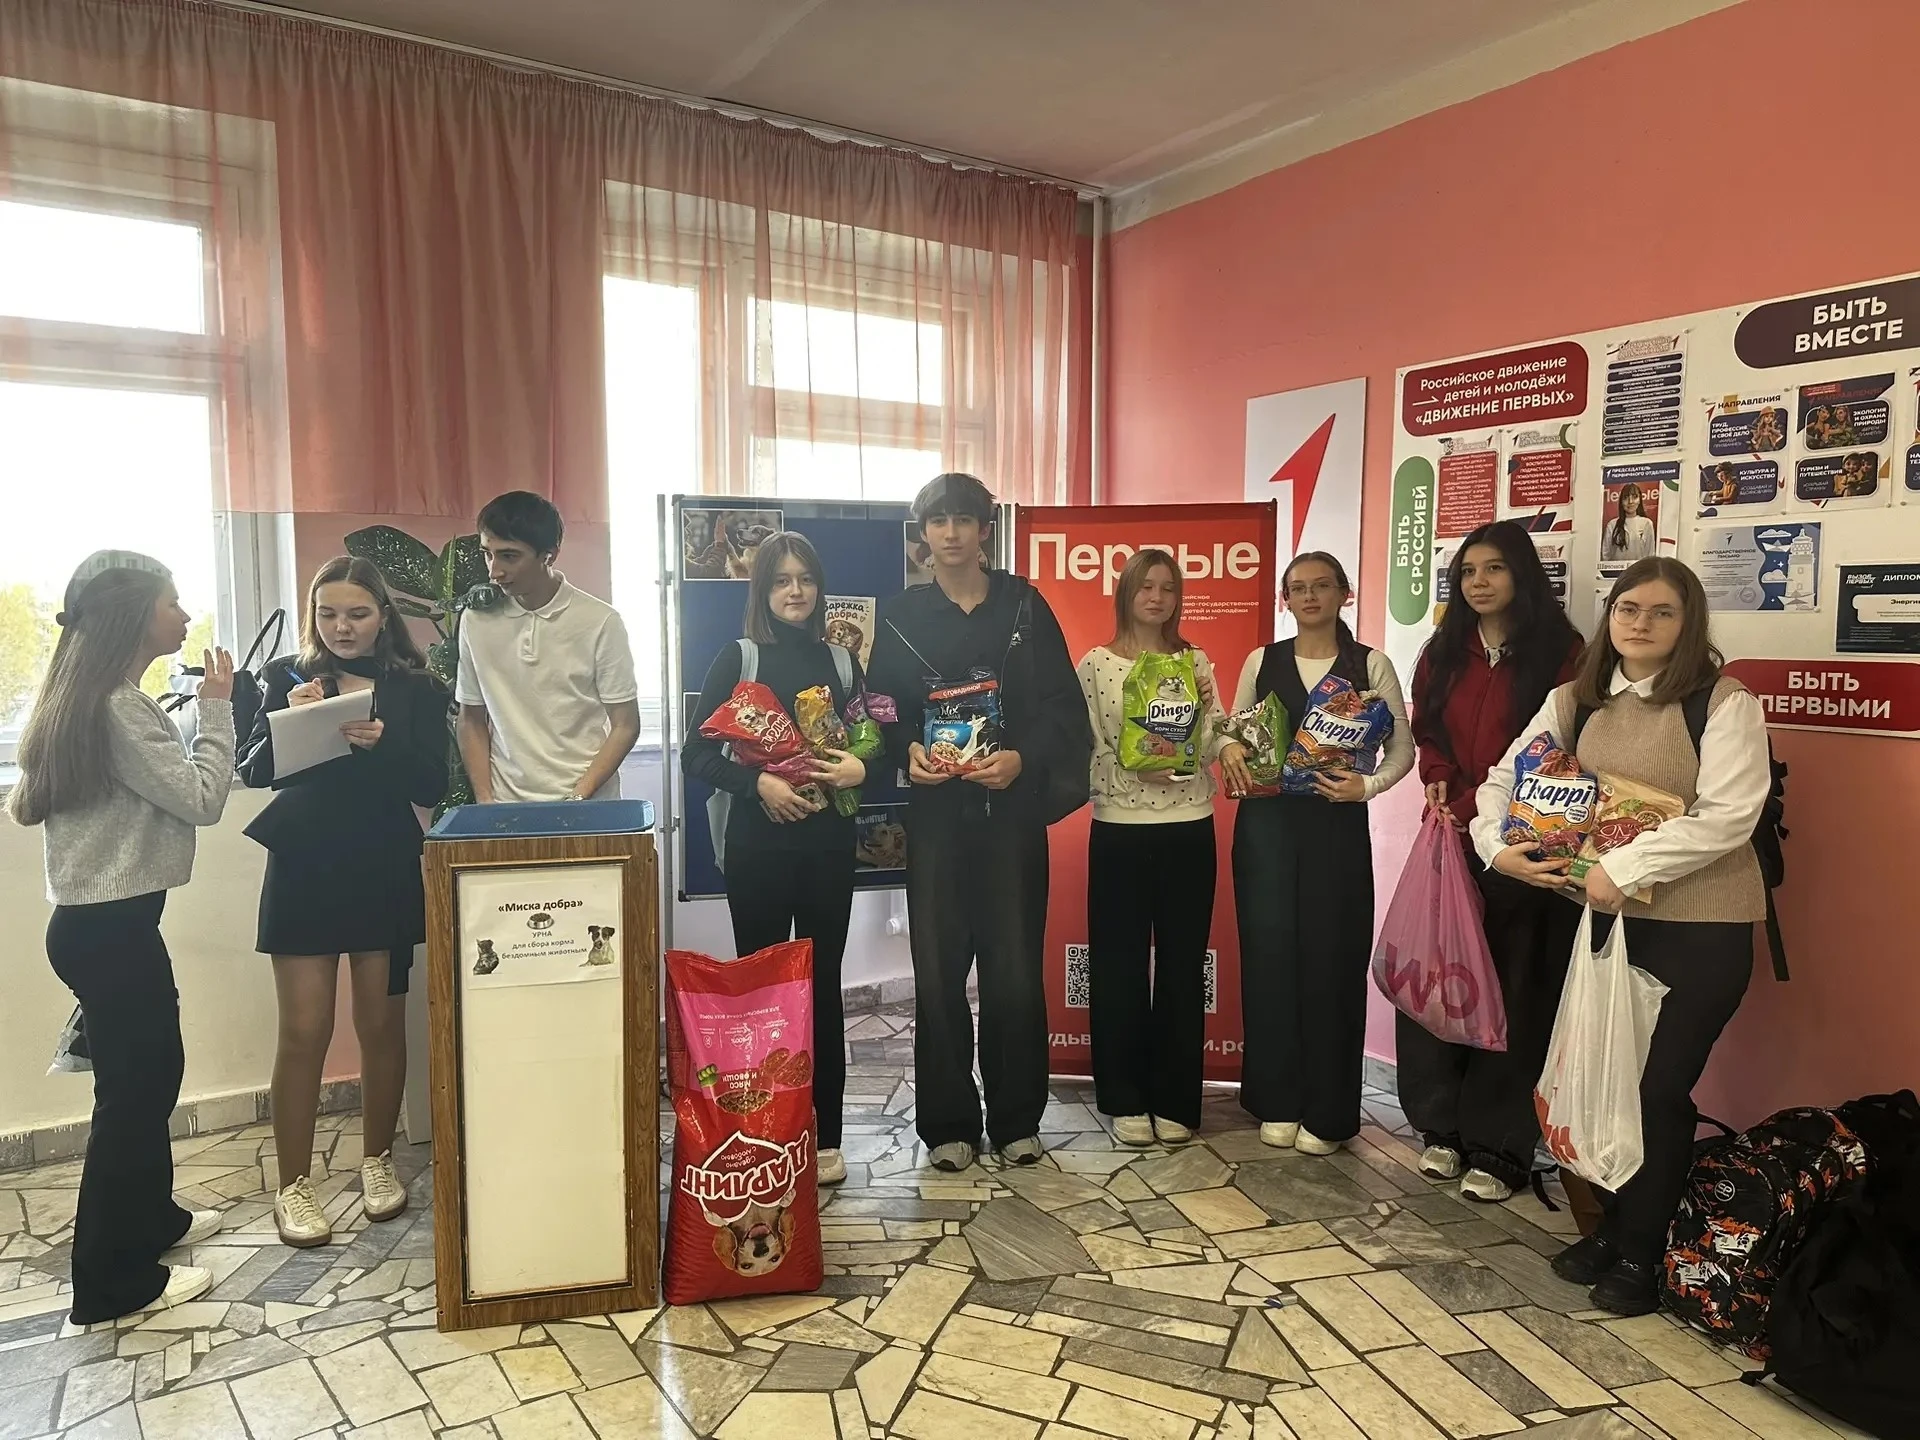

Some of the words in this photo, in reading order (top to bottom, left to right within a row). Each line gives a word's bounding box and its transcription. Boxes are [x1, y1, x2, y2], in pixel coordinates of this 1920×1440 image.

[1812, 296, 1888, 326] БЫТЬ
[1794, 318, 1904, 353] ВМЕСТЕ
[1420, 367, 1495, 392] Российское
[1497, 355, 1568, 380] движение
[1443, 385, 1481, 404] детей
[1483, 386, 1491, 397] и
[1494, 372, 1567, 393] молодёжи
[1415, 399, 1500, 427] «ДВИЖЕНИЕ
[1502, 390, 1575, 413] ПЕРВЫХ»
[1718, 395, 1781, 409] НАПРАВЛЕНИЯ
[1853, 407, 1887, 416] ЭКОЛОГИЯ
[1854, 418, 1887, 427] ПРИРОДЫ
[1860, 413, 1887, 421] ОХРАНА
[1733, 430, 1750, 438] ДЕЛО
[1800, 469, 1843, 477] ПУТЕШЕСТВИЯ
[1396, 514, 1411, 567] БЫТЬ
[1411, 484, 1428, 580] РОССИЕЙ
[1411, 584, 1424, 596] С
[1788, 671, 1860, 692] БЫТЬ
[1151, 703, 1191, 722] Dingo
[1757, 694, 1891, 719] ПЕРВЫМИ
[1302, 711, 1365, 742] Chappi
[1515, 777, 1594, 808] Chappi
[498, 902, 540, 913] «Миска
[543, 899, 583, 912] добра»
[532, 930, 552, 938] УРНА
[501, 949, 546, 960] бездомным
[547, 947, 588, 957] животным
[512, 942, 526, 950] для
[528, 939, 550, 948] сбора
[551, 938, 575, 947] корма
[729, 1079, 751, 1090] МЯСО
[681, 1130, 810, 1199] ДАРЛИНГ
